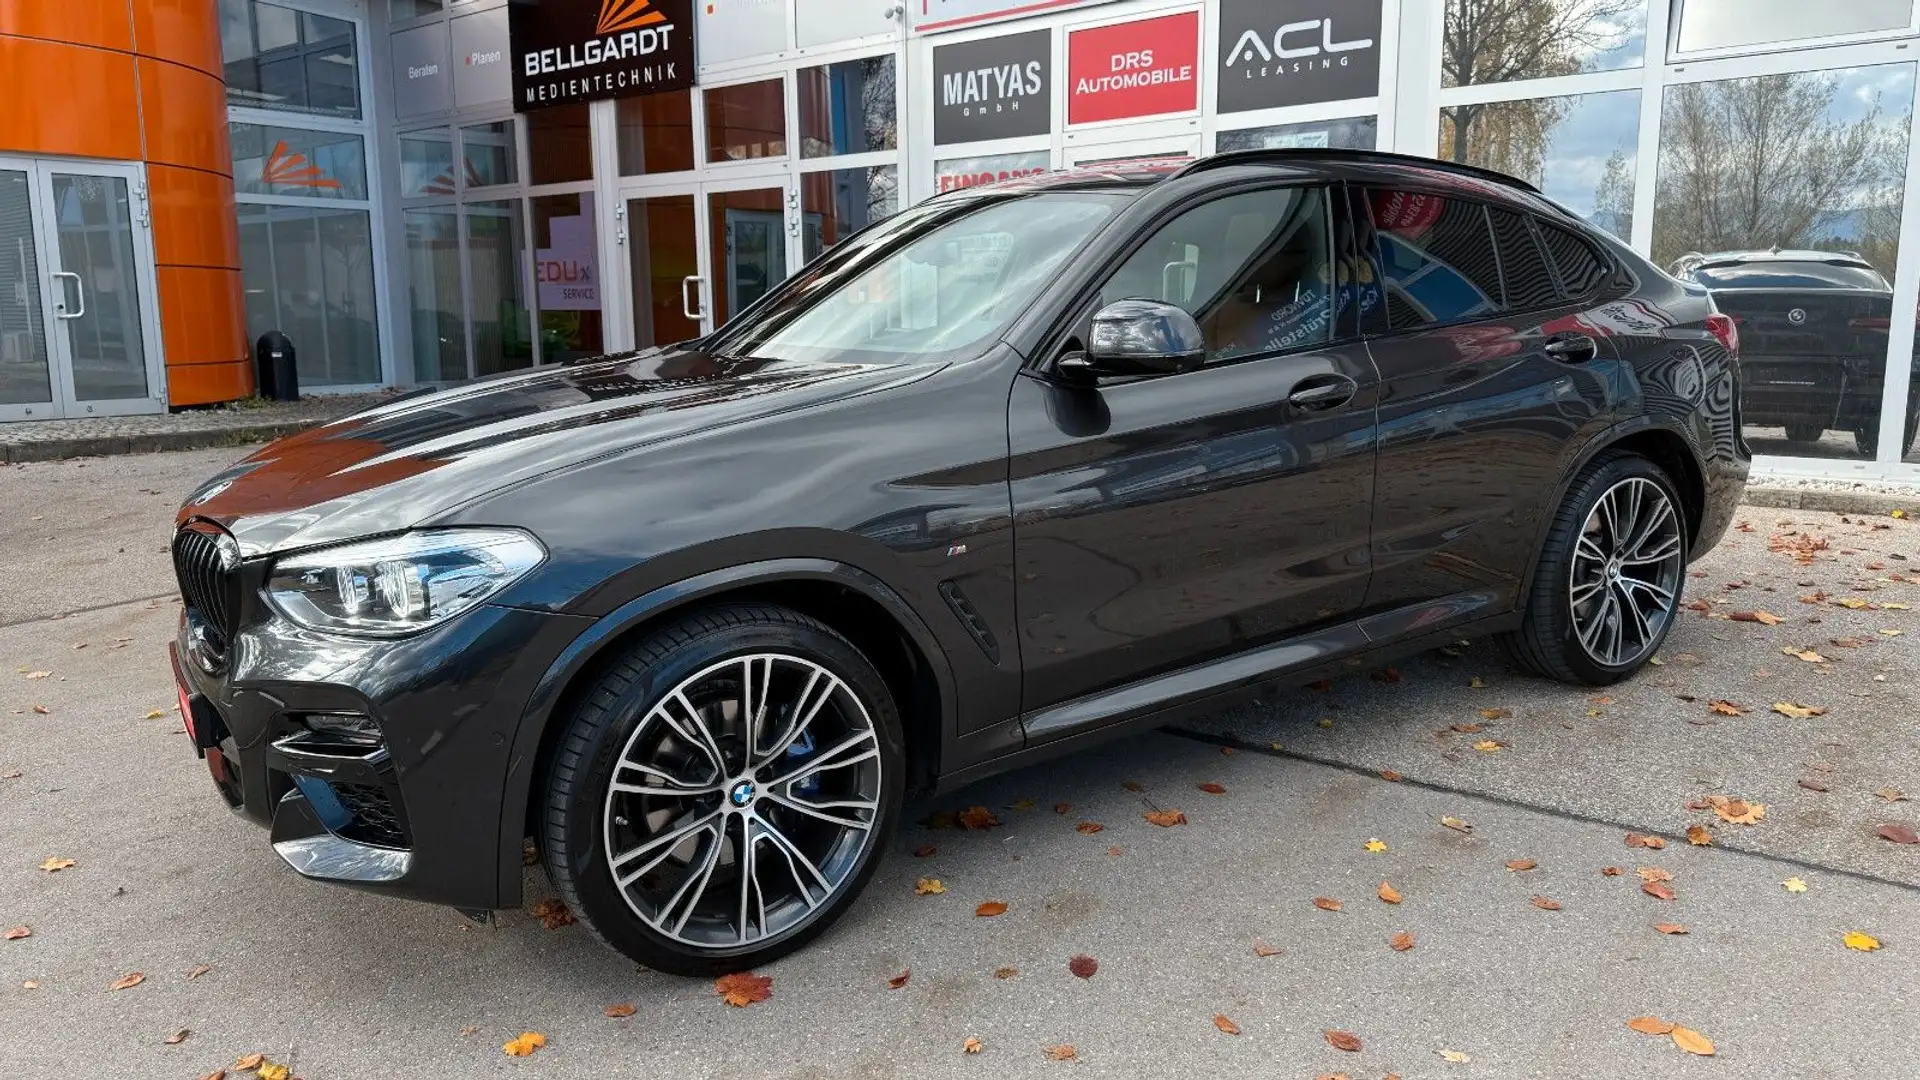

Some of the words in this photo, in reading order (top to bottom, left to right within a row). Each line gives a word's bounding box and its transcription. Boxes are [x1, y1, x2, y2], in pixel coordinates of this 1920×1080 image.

[525, 24, 675, 77] BELLGARDT
[1225, 18, 1373, 67] ACL
[472, 51, 500, 67] Planen
[1111, 50, 1153, 72] DRS
[1246, 56, 1348, 79] LEASING
[408, 64, 438, 79] Beraten
[526, 63, 677, 103] MEDIENTECHNIK
[1075, 65, 1192, 95] AUTOMOBILE
[943, 61, 1042, 106] MATYAS
[963, 101, 1019, 116] GmbH
[562, 288, 594, 300] SERVICE
